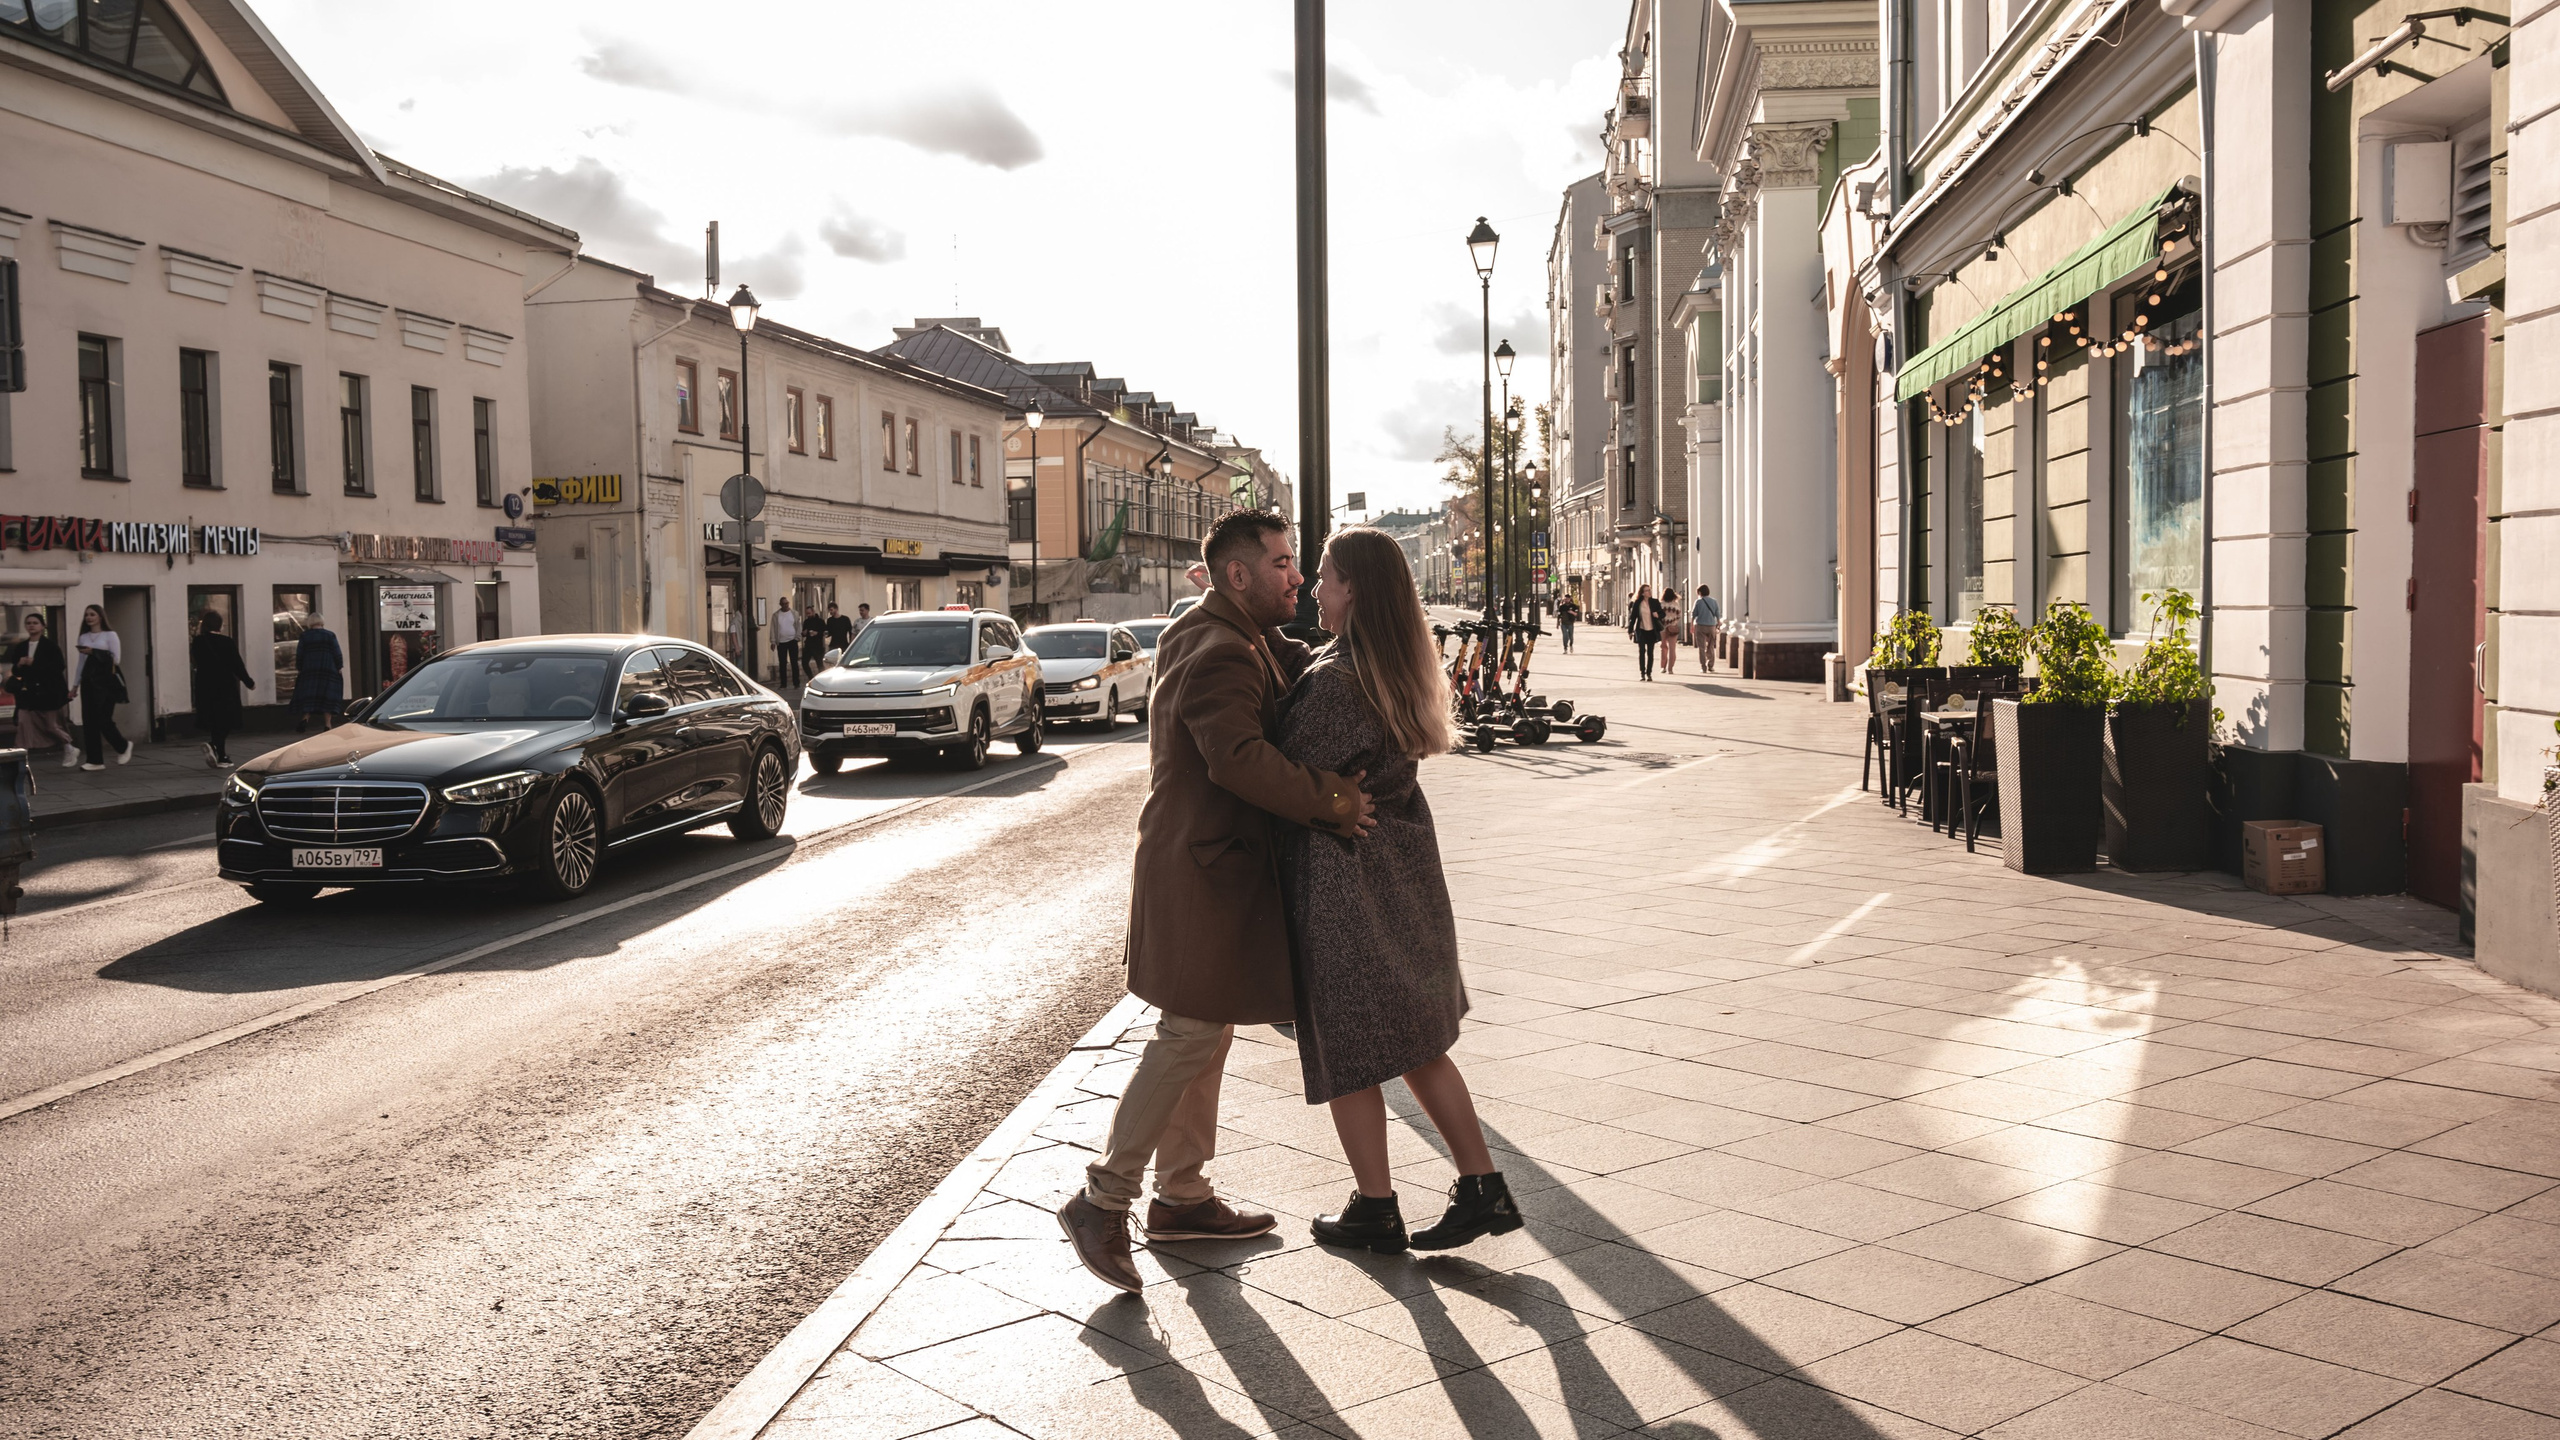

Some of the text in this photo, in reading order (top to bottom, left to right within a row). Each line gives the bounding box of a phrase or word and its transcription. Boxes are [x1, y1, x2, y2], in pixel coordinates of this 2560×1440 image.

[561, 475, 620, 504] ФИШ
[512, 497, 520, 511] 12
[112, 522, 260, 555] МАГАЗИН МЕЧТЫ
[452, 540, 503, 563] ПРОДУКТЫ
[381, 591, 432, 600] Рюмочная
[396, 621, 421, 629] VAPE
[355, 850, 378, 862] 797
